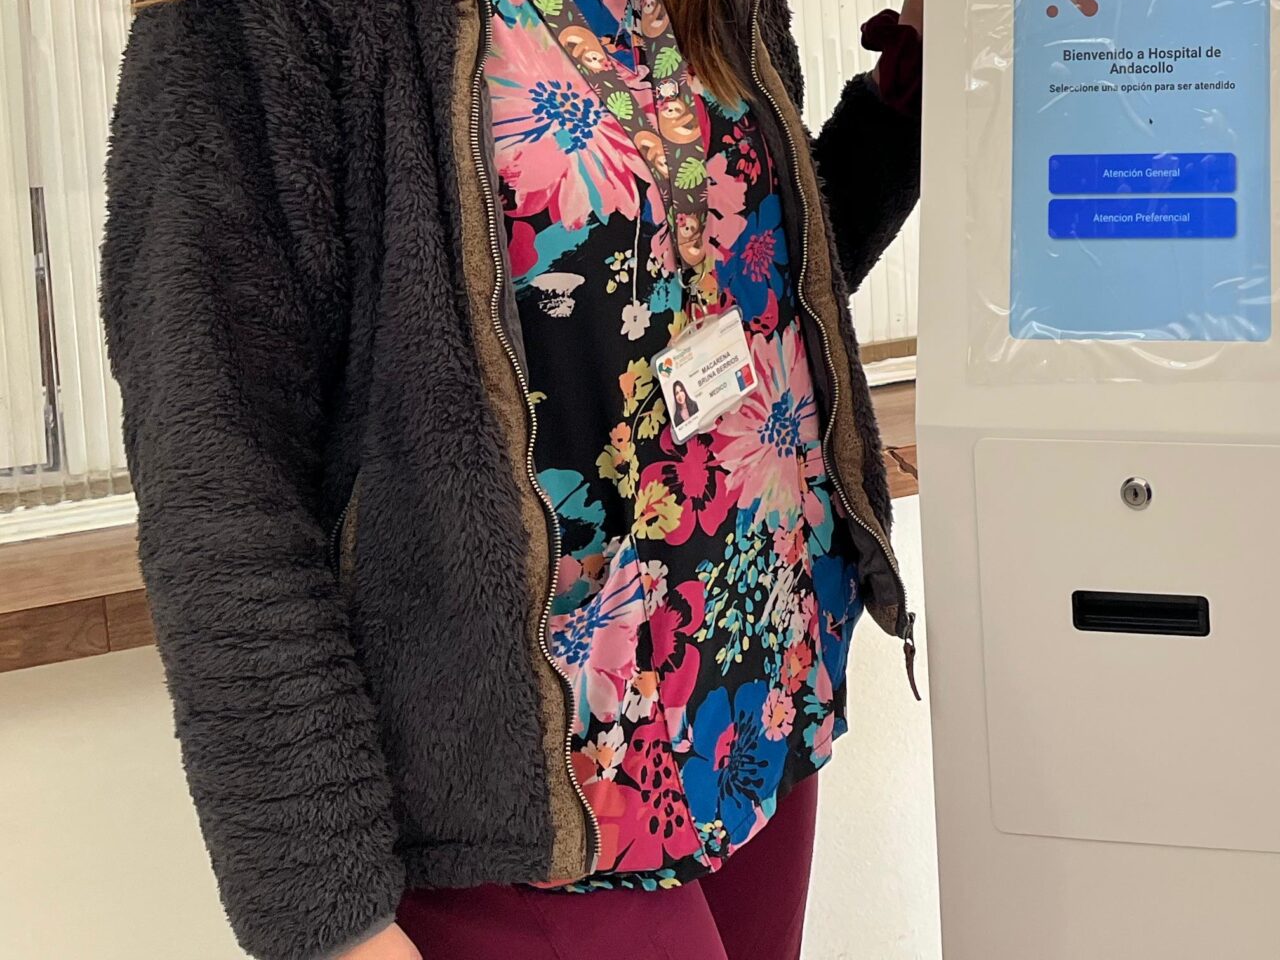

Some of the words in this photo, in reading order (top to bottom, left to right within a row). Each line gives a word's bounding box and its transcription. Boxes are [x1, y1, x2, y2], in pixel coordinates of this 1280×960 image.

[1063, 48, 1133, 61] Bienvenido
[1137, 50, 1144, 59] a
[1149, 46, 1201, 62] Hospital
[1205, 46, 1221, 58] de
[1110, 61, 1174, 74] Andacollo
[1050, 83, 1099, 93] Seleccione
[1121, 82, 1150, 93] opción
[1154, 83, 1175, 92] para
[1178, 83, 1192, 91] ser
[1195, 81, 1235, 90] atendido
[1103, 168, 1143, 178] Atención
[1145, 168, 1180, 177] General
[1093, 213, 1133, 222] Atencion
[1135, 212, 1190, 222] Preferencial
[701, 351, 731, 374] MACARENA
